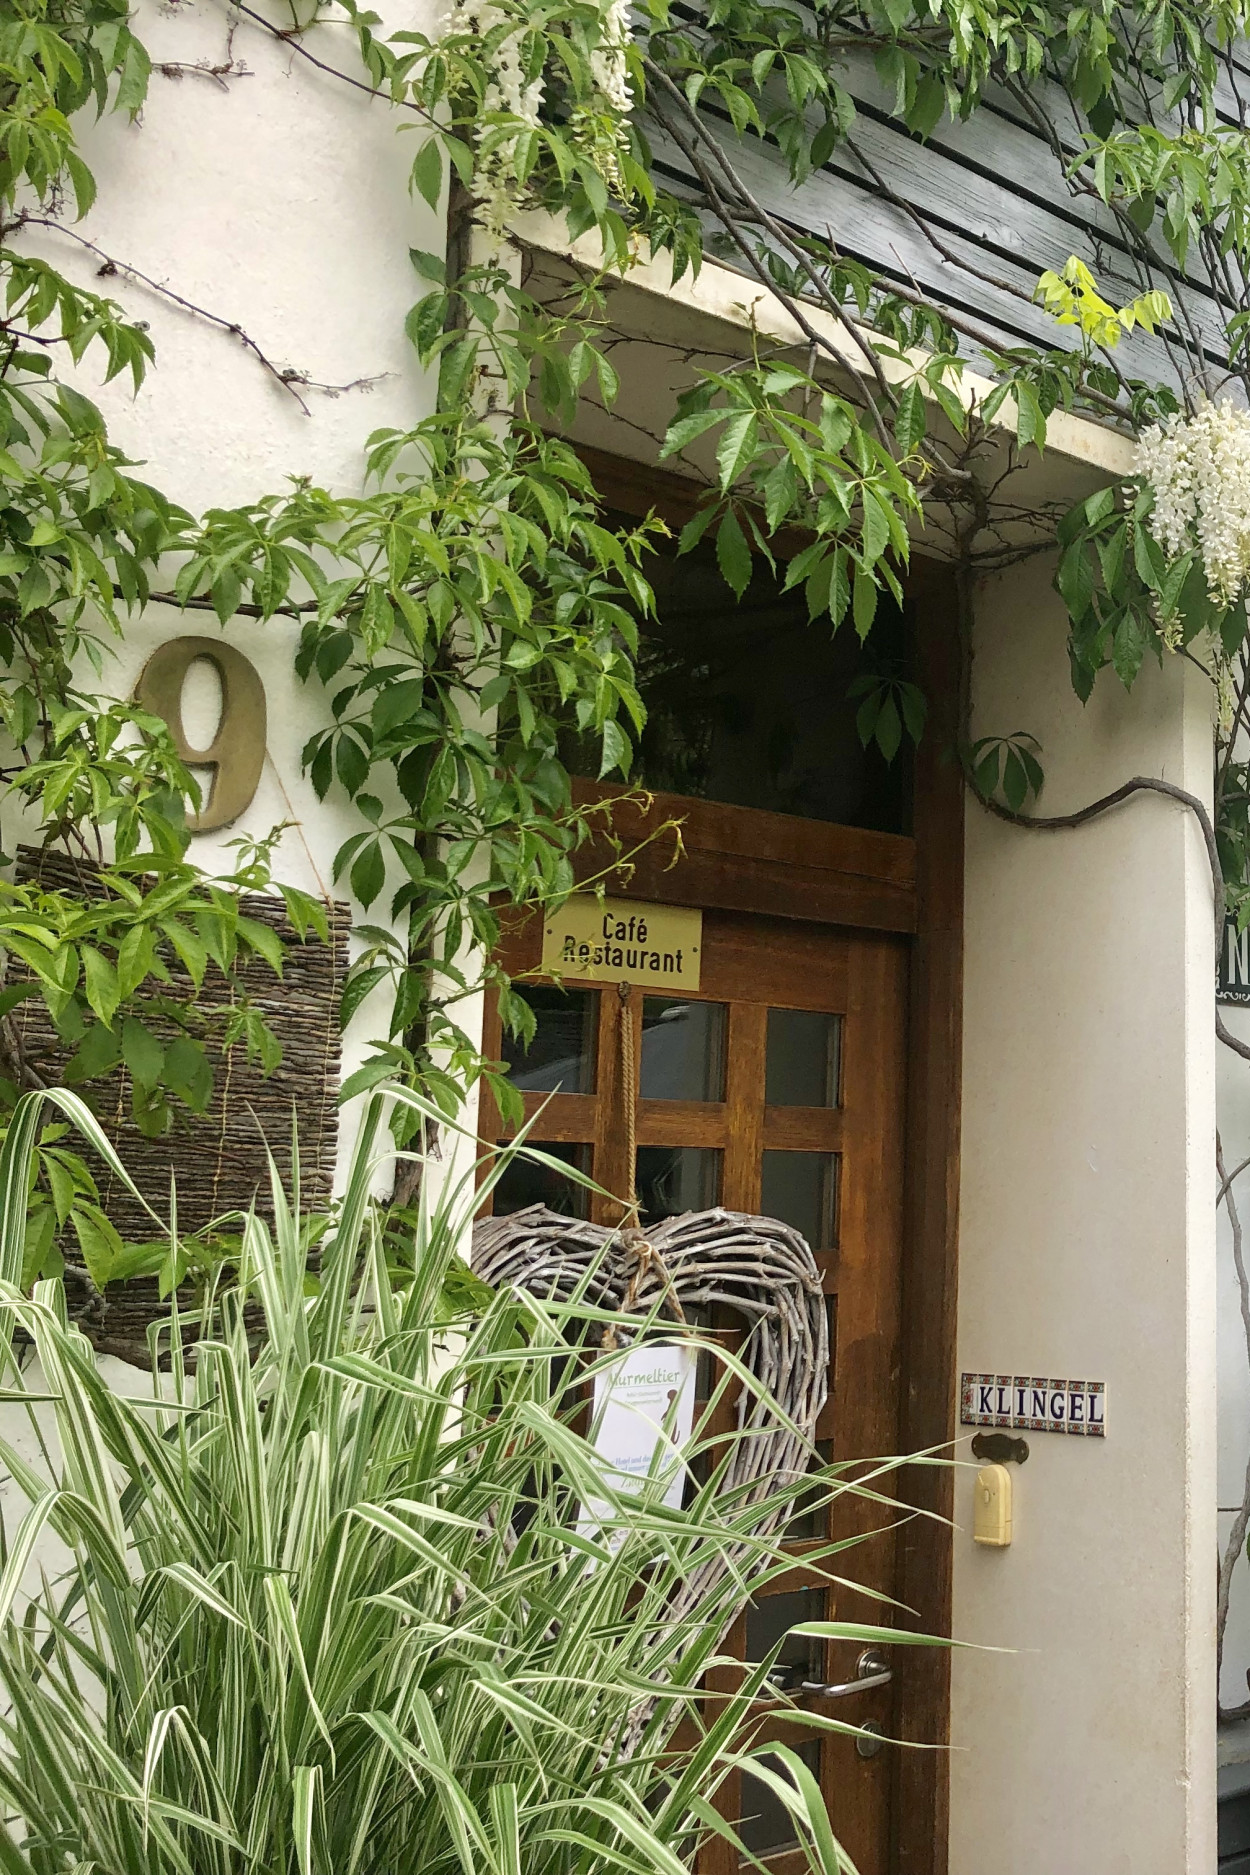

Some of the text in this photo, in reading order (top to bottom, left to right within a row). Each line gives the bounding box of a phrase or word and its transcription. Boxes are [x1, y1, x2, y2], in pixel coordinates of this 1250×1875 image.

[134, 635, 268, 836] 9
[602, 912, 648, 944] Café
[563, 935, 683, 974] Restaurant
[979, 1385, 1104, 1423] KLINGEL
